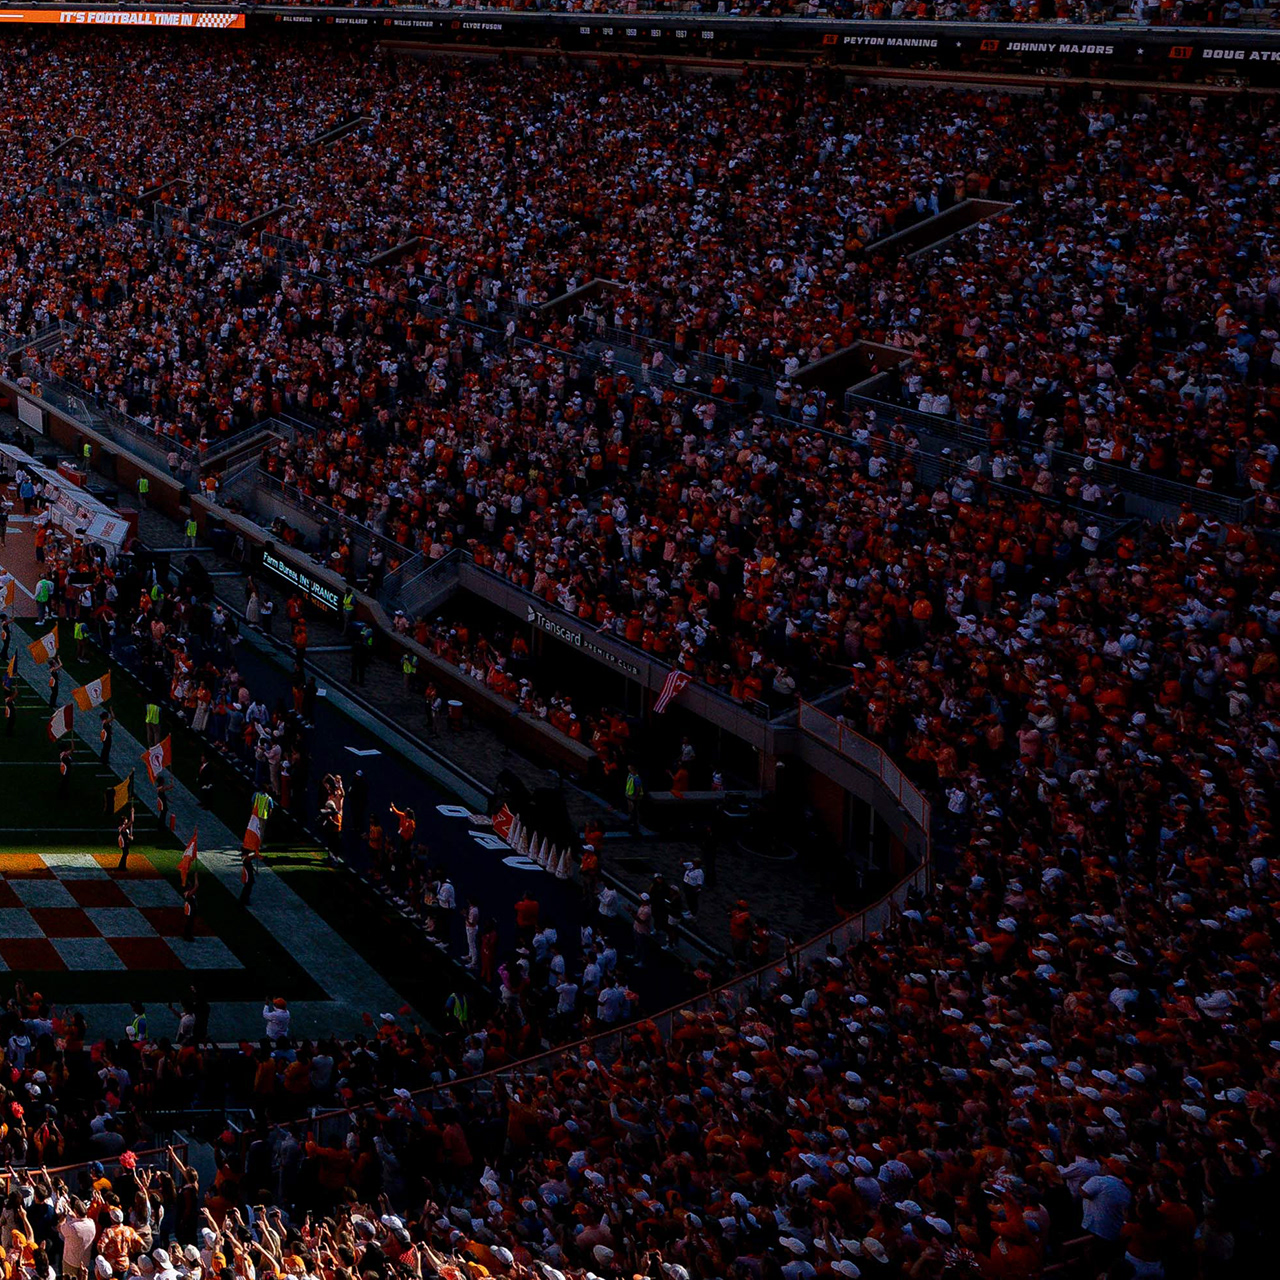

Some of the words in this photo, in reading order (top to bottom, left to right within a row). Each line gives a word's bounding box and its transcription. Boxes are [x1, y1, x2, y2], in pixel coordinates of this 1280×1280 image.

[60, 12, 85, 23] IT'S
[87, 12, 153, 25] FOOTBALL
[154, 13, 180, 25] TIME
[181, 14, 193, 25] IN
[844, 36, 885, 46] PEYTON
[886, 38, 938, 47] MANNING
[1006, 42, 1057, 52] JOHNNY
[1059, 44, 1115, 54] MAJORS
[1202, 49, 1245, 59] DOUG
[263, 552, 279, 568] Farm
[536, 612, 582, 646] Transcard
[584, 640, 615, 661] PREMIER
[618, 659, 637, 674] CLUB
